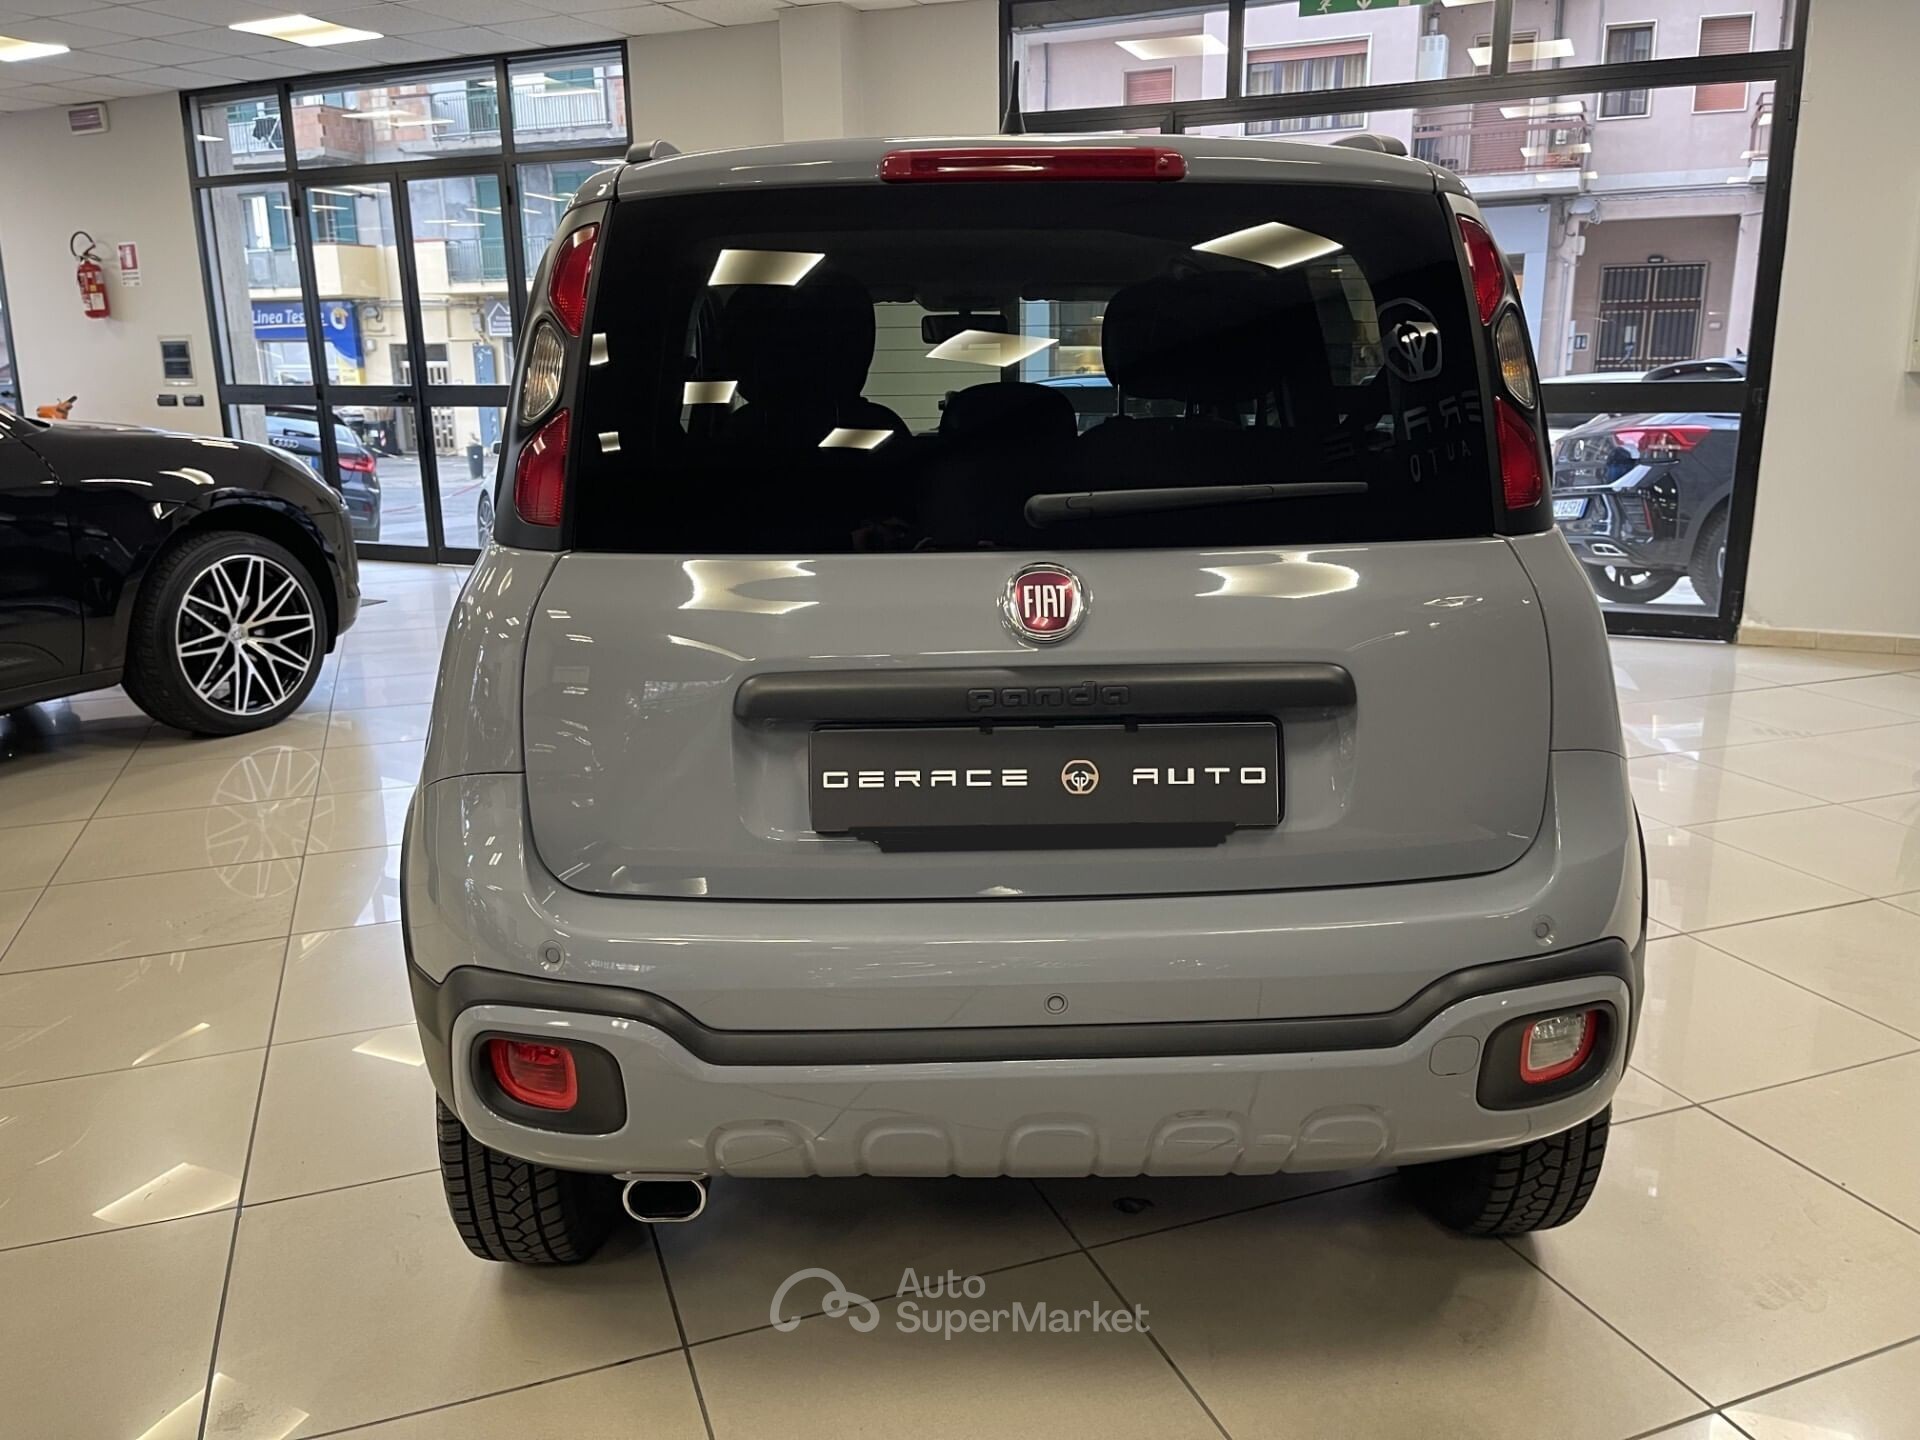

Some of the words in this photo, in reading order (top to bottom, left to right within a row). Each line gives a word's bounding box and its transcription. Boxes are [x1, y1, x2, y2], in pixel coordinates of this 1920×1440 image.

[252, 309, 283, 325] Linea
[1023, 585, 1069, 617] FIAT
[968, 681, 1129, 712] panda
[822, 768, 1029, 789] GERACE
[1132, 766, 1267, 786] AUTO
